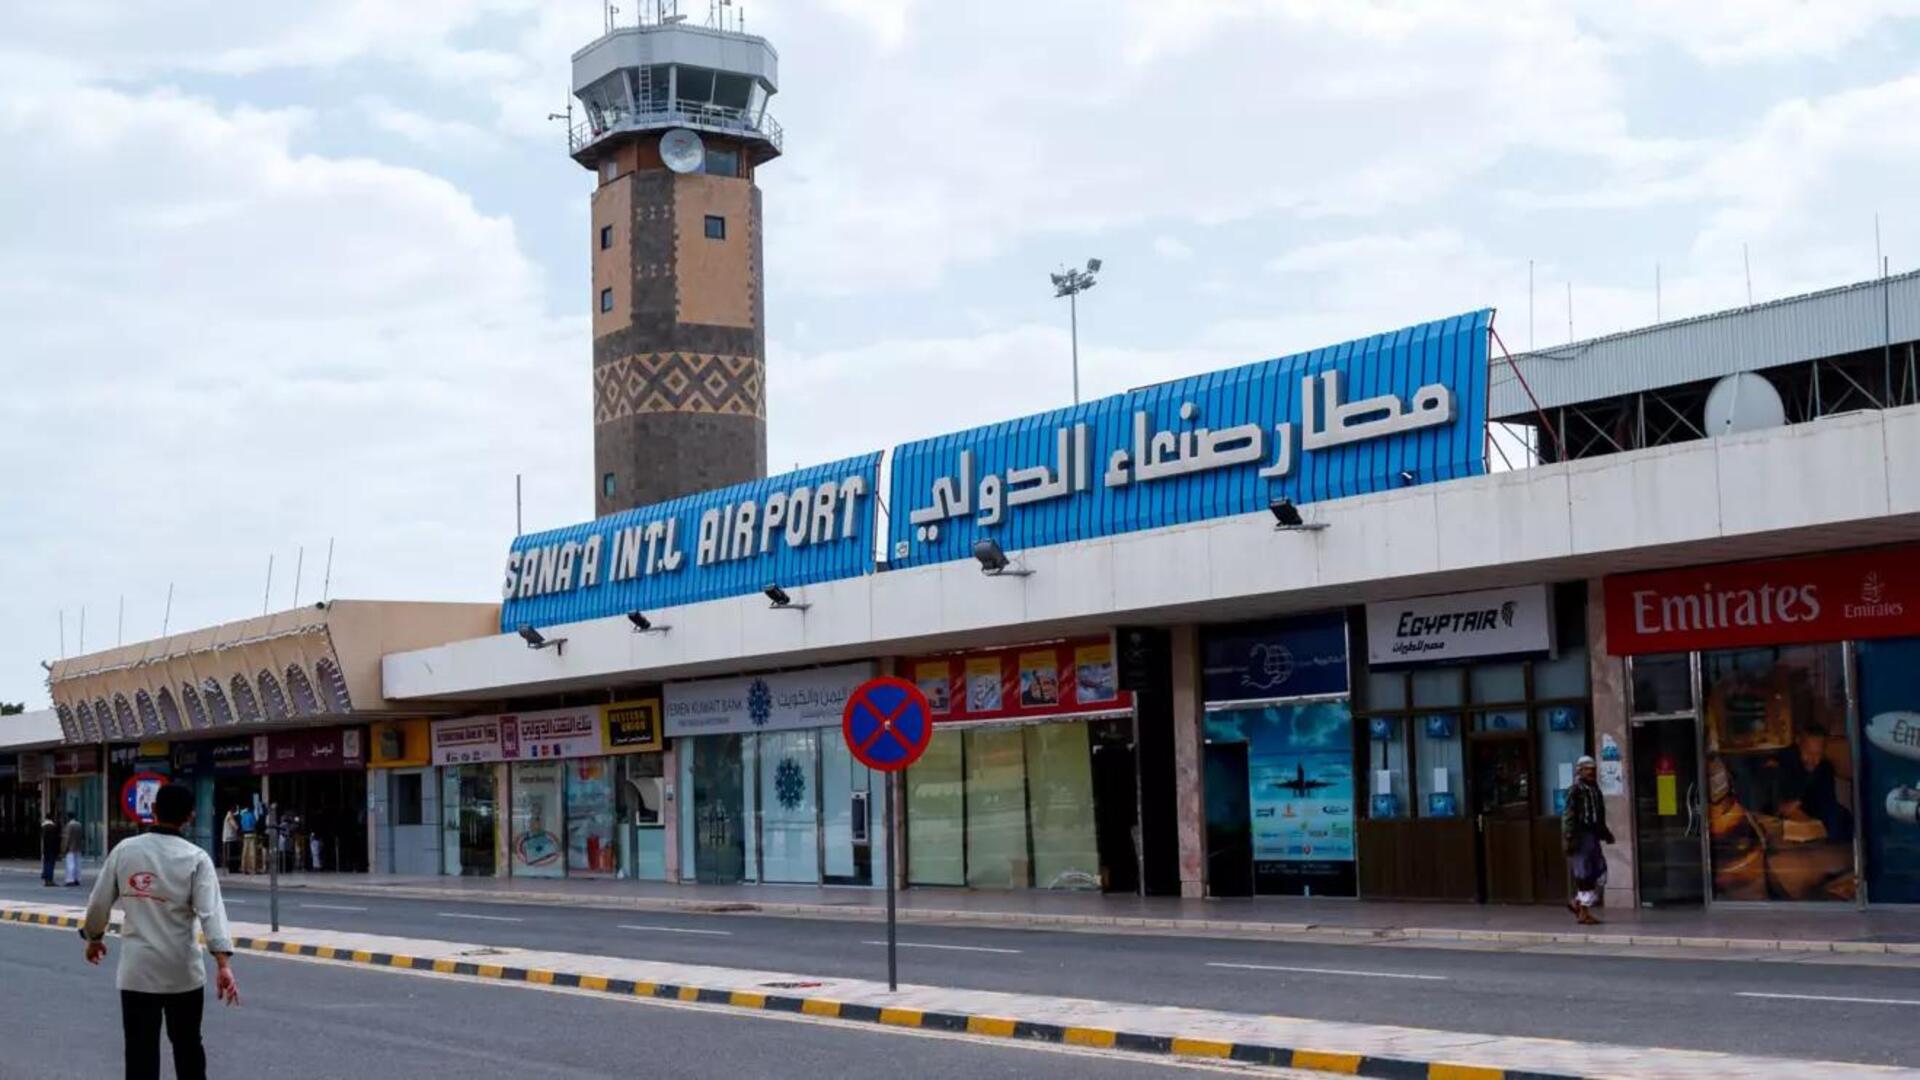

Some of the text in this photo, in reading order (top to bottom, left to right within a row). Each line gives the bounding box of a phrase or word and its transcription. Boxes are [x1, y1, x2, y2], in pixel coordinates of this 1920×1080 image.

[909, 369, 1456, 543] مطار صنعاء الدولي
[697, 475, 867, 566] AIRPORT
[1632, 582, 1821, 634] Emirates
[1844, 602, 1903, 618] Emirates
